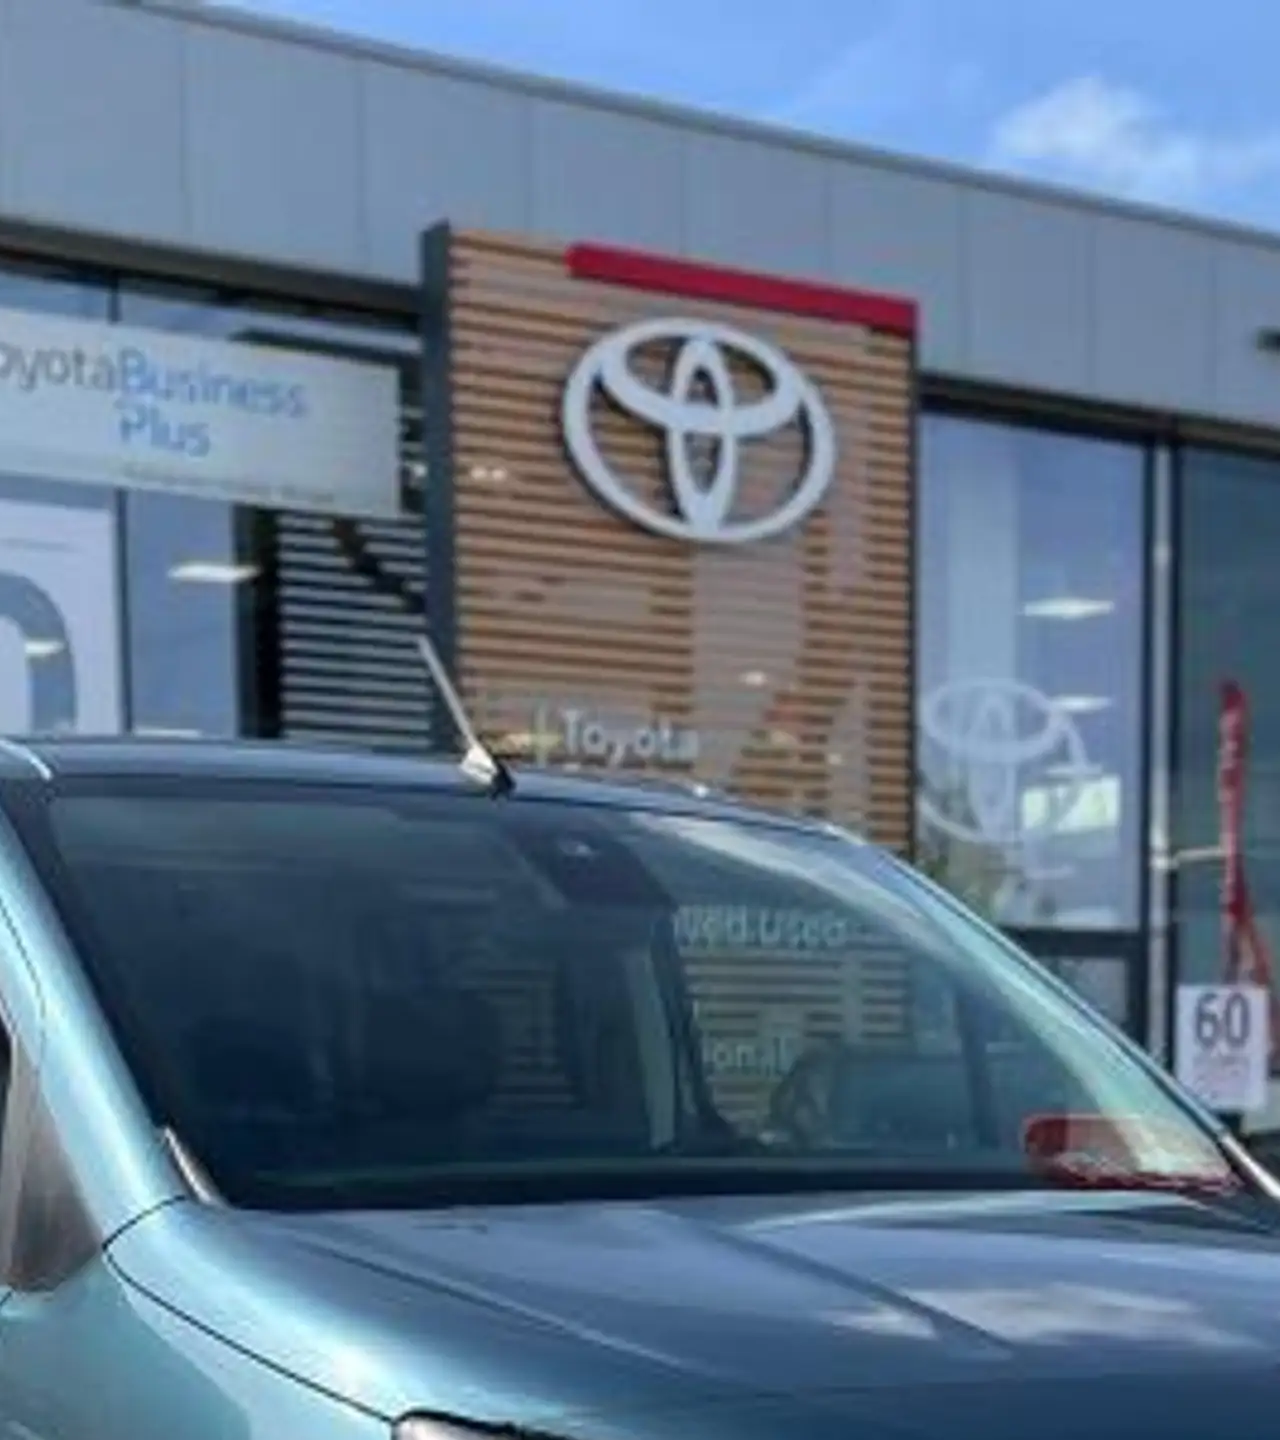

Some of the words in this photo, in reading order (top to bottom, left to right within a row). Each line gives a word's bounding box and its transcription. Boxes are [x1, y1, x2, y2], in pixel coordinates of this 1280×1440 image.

[118, 400, 211, 458] Plus
[560, 706, 699, 766] Toyota
[1194, 991, 1252, 1051] 60
